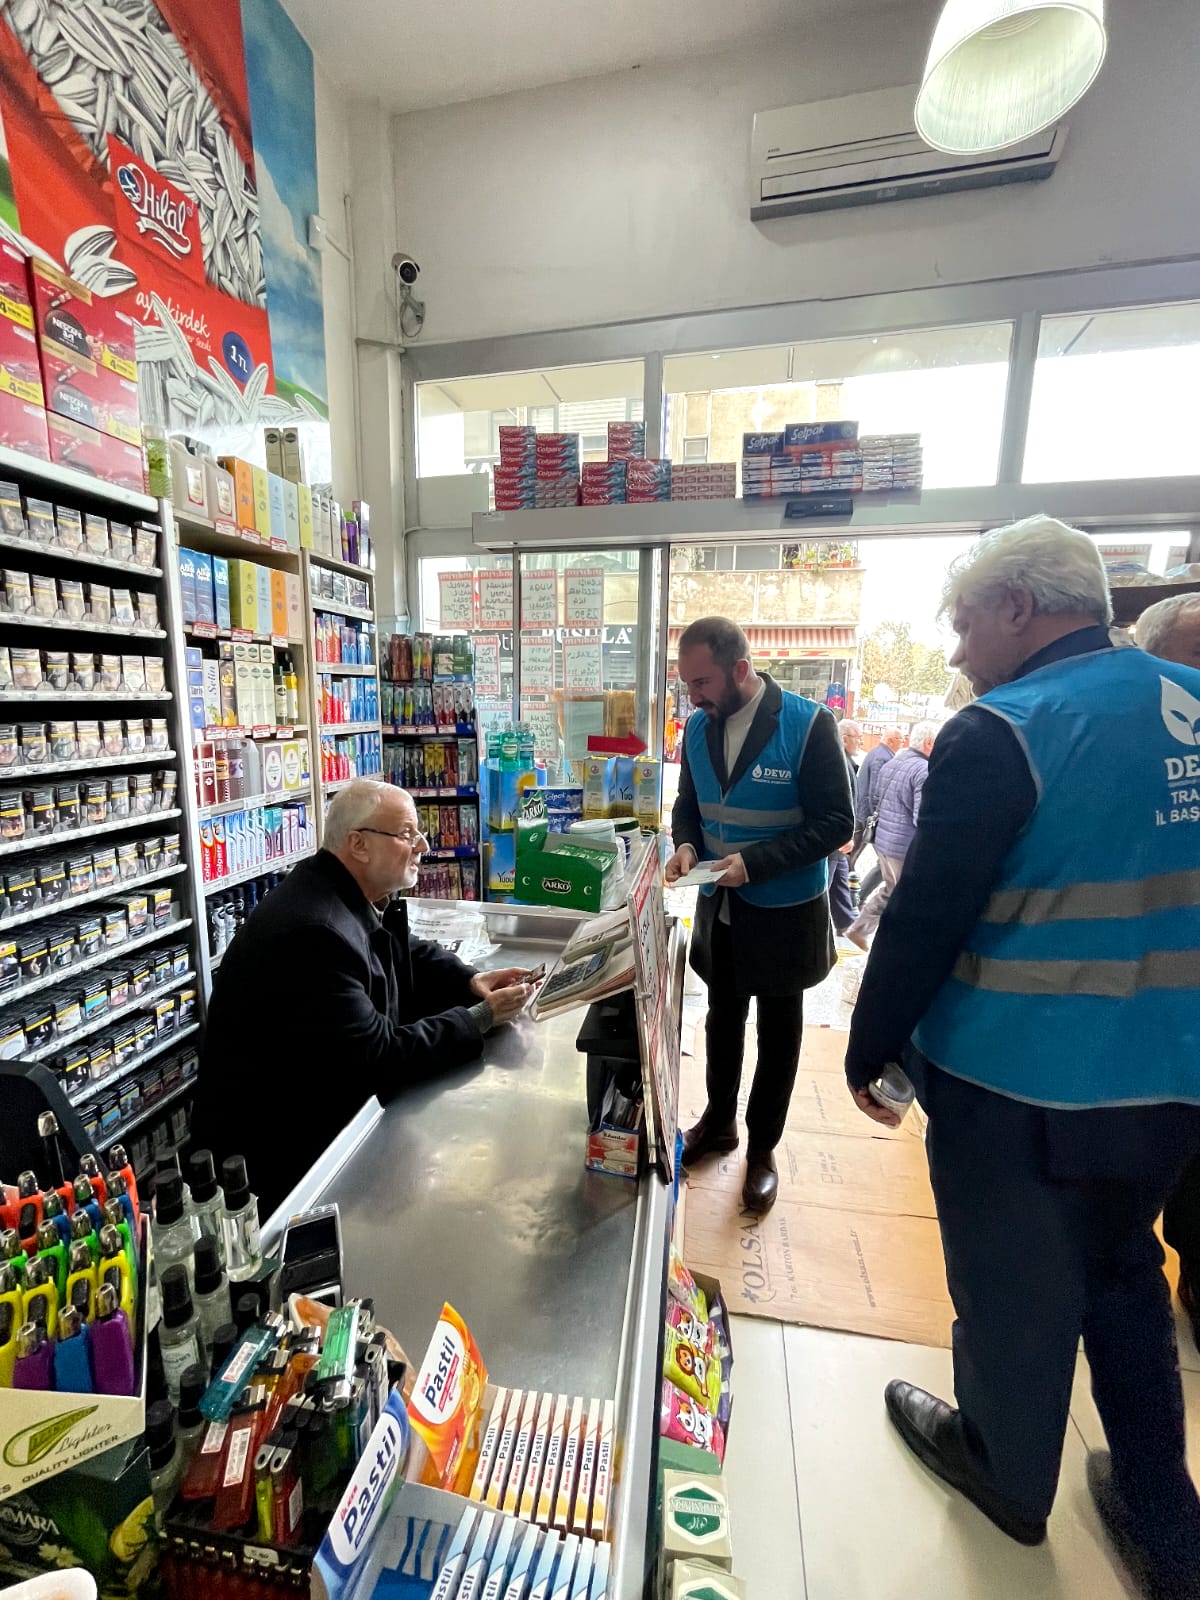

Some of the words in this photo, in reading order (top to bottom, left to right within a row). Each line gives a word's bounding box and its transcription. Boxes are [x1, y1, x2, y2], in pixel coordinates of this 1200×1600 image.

[748, 434, 779, 449] Selpak
[791, 425, 825, 441] Selpak
[763, 767, 792, 778] DEVA
[1165, 754, 1200, 780] DE
[1170, 789, 1200, 804] TRA
[1155, 809, 1167, 826] İL
[1170, 805, 1200, 823] BAŞ
[544, 881, 570, 891] ARKO
[425, 1335, 455, 1408] Pastil
[55, 1423, 112, 1455] Lighter
[482, 1427, 496, 1457] Pastil
[499, 1429, 512, 1460] Pastil
[516, 1432, 528, 1462] Pastil
[532, 1434, 544, 1464] Pastil
[548, 1435, 560, 1466] Pastil
[565, 1437, 576, 1468] Pastil
[22, 1457, 70, 1483] QUALITY
[72, 1434, 119, 1460] LIGHTER
[583, 1440, 594, 1471] Pastil
[599, 1441, 610, 1472] Pastil
[344, 1425, 397, 1545] Pastil
[435, 1568, 453, 1600] astil
[462, 1574, 475, 1600] stil
